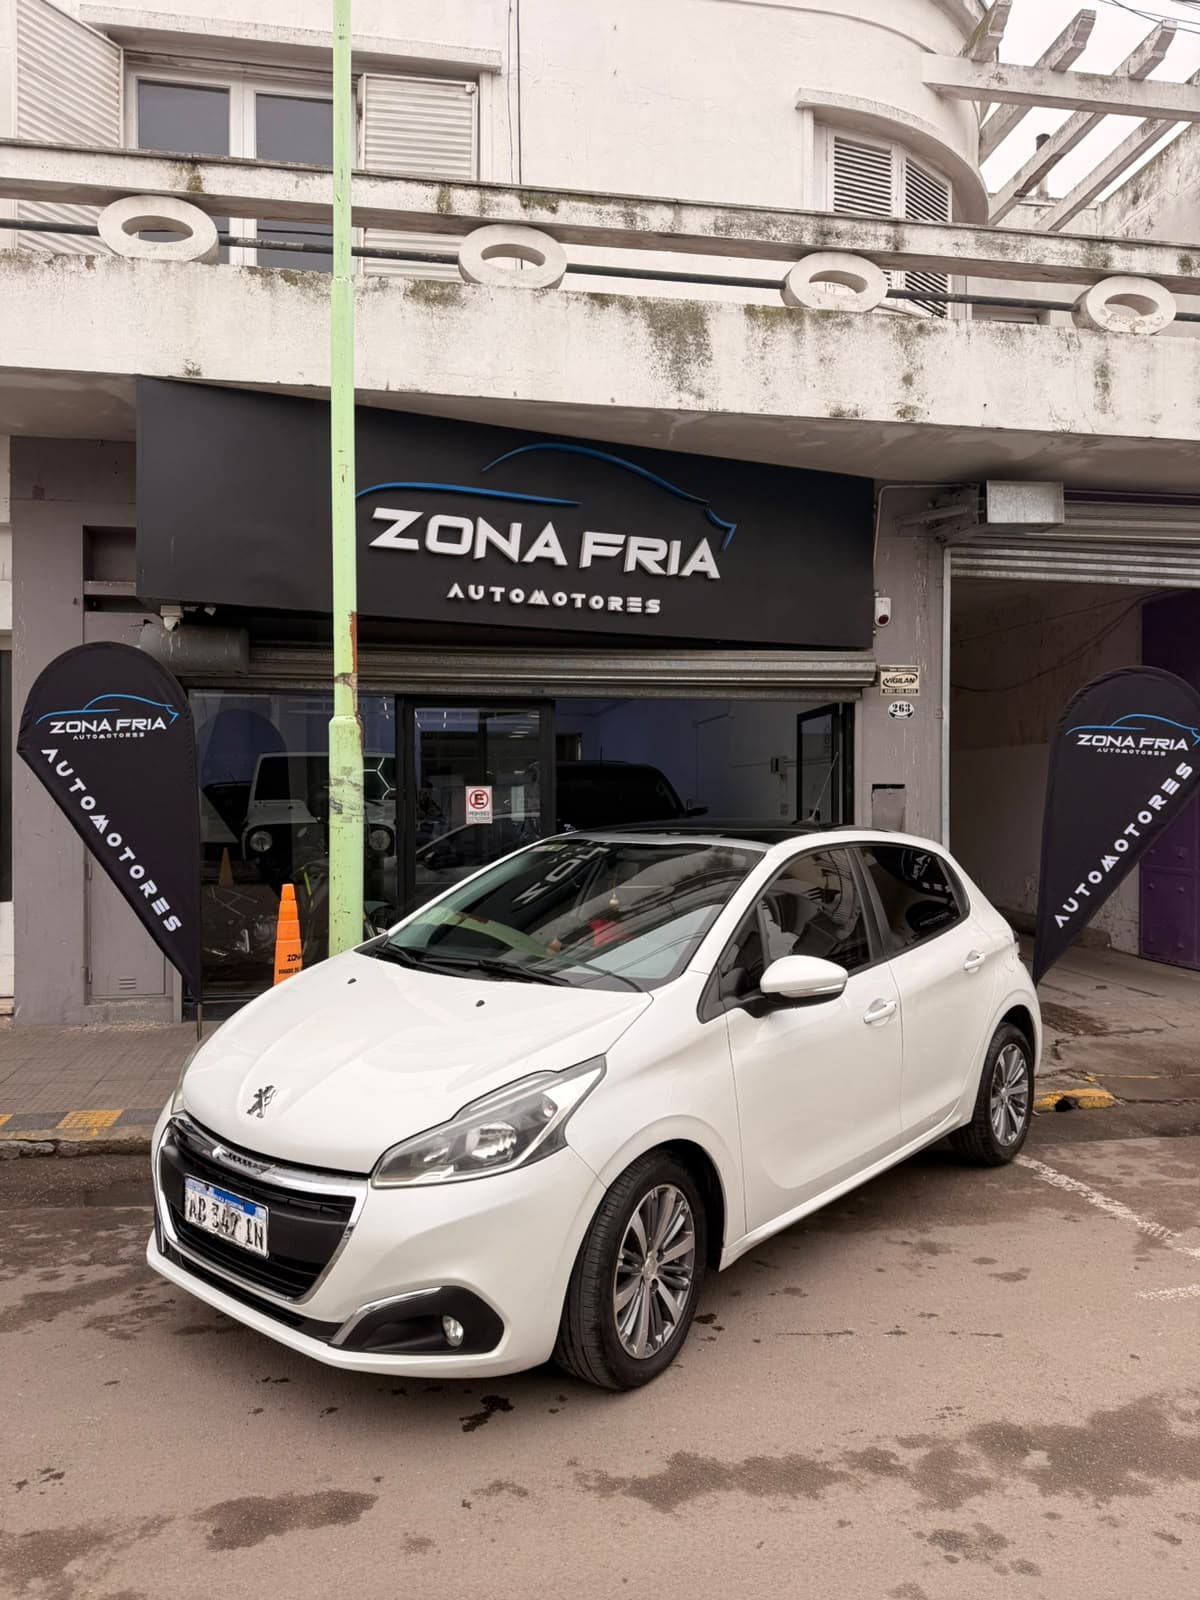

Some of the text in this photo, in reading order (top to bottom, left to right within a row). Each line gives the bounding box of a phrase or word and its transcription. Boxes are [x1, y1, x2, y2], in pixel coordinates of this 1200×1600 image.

[369, 507, 721, 579] ZONA FRIA
[447, 582, 661, 614] AUTOMOTORES
[892, 703, 911, 713] 263
[49, 716, 167, 734] ZONA FRIA
[72, 732, 145, 740] AUTOMOTORES
[1076, 734, 1189, 751] ZONA FRIA
[1096, 748, 1166, 756] AUTOMOTORES
[41, 749, 182, 932] AUTOMOTORES
[1054, 762, 1193, 928] AUTOMOTORES
[211, 1202, 242, 1236] 347
[246, 1217, 264, 1250] IN
